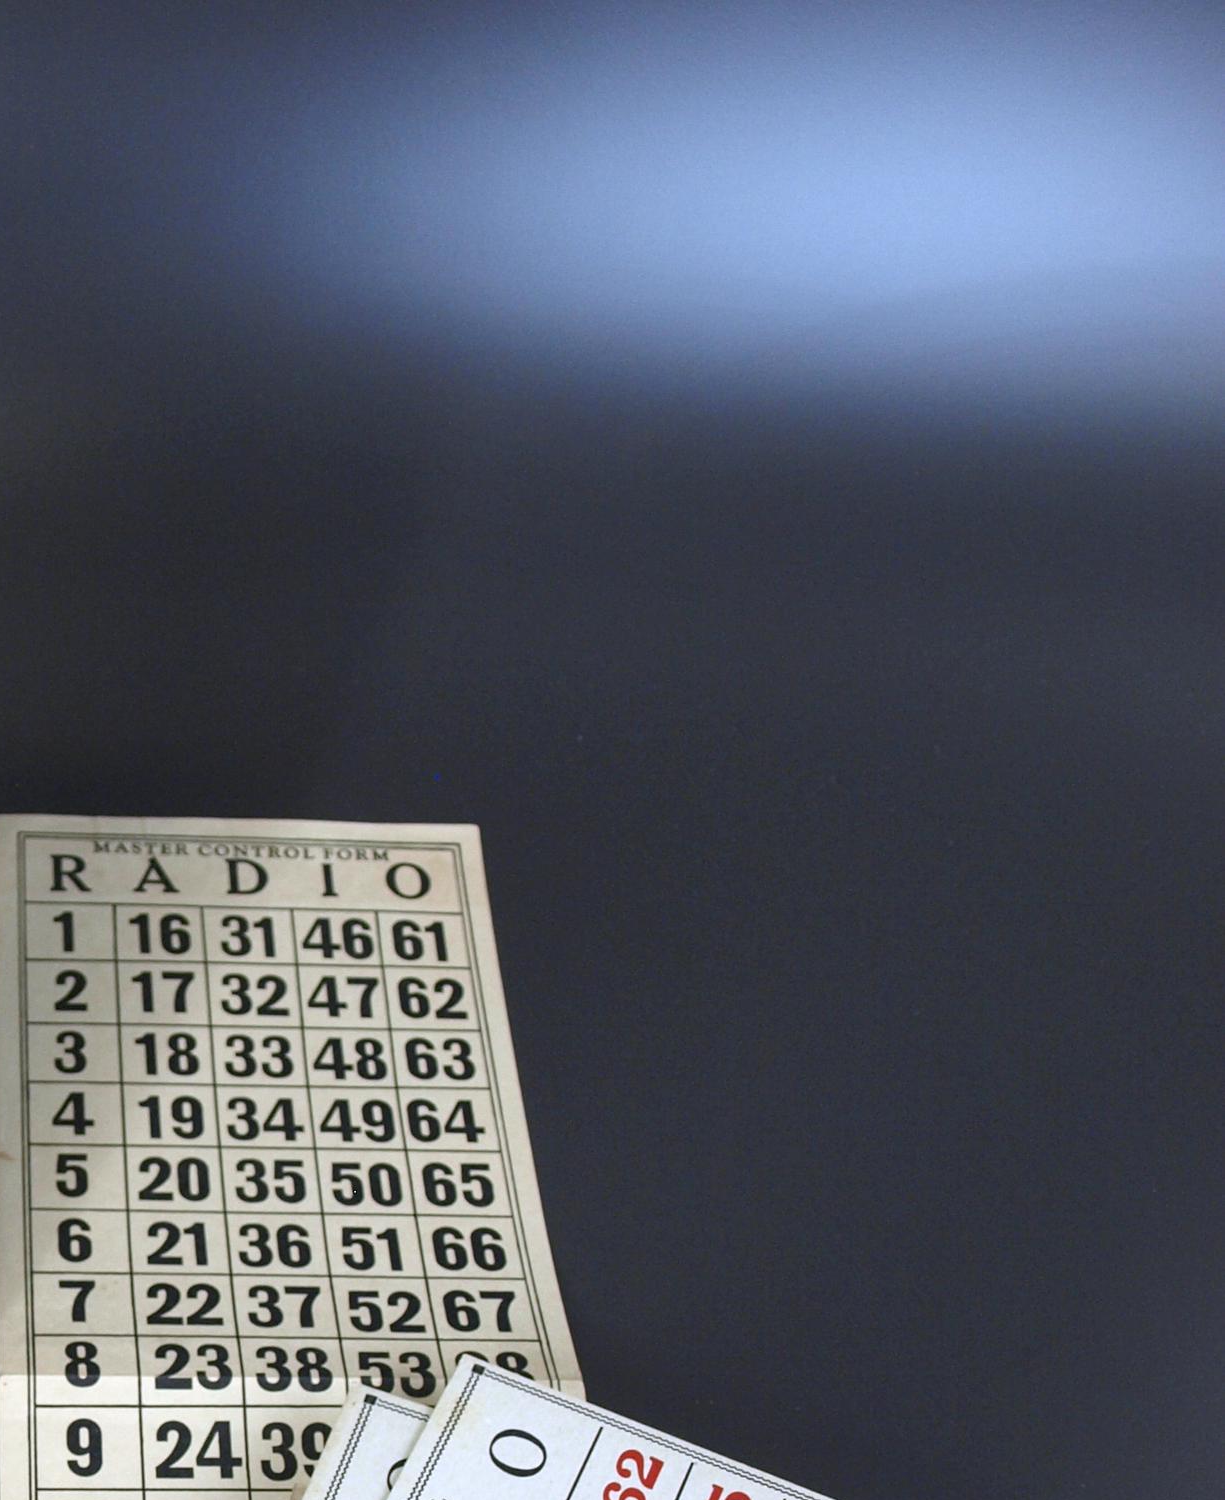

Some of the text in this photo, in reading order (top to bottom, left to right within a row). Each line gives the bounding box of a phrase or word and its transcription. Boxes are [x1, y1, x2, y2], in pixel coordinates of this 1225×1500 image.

[93, 839, 390, 862] MASTER CONTROL FORM
[53, 912, 447, 961] 1 16 31 46 61
[64, 1341, 101, 1388] 8
[153, 1342, 234, 1391] 23
[255, 1345, 333, 1394] 38
[358, 1351, 437, 1398] 53
[66, 1419, 243, 1479] 9 24
